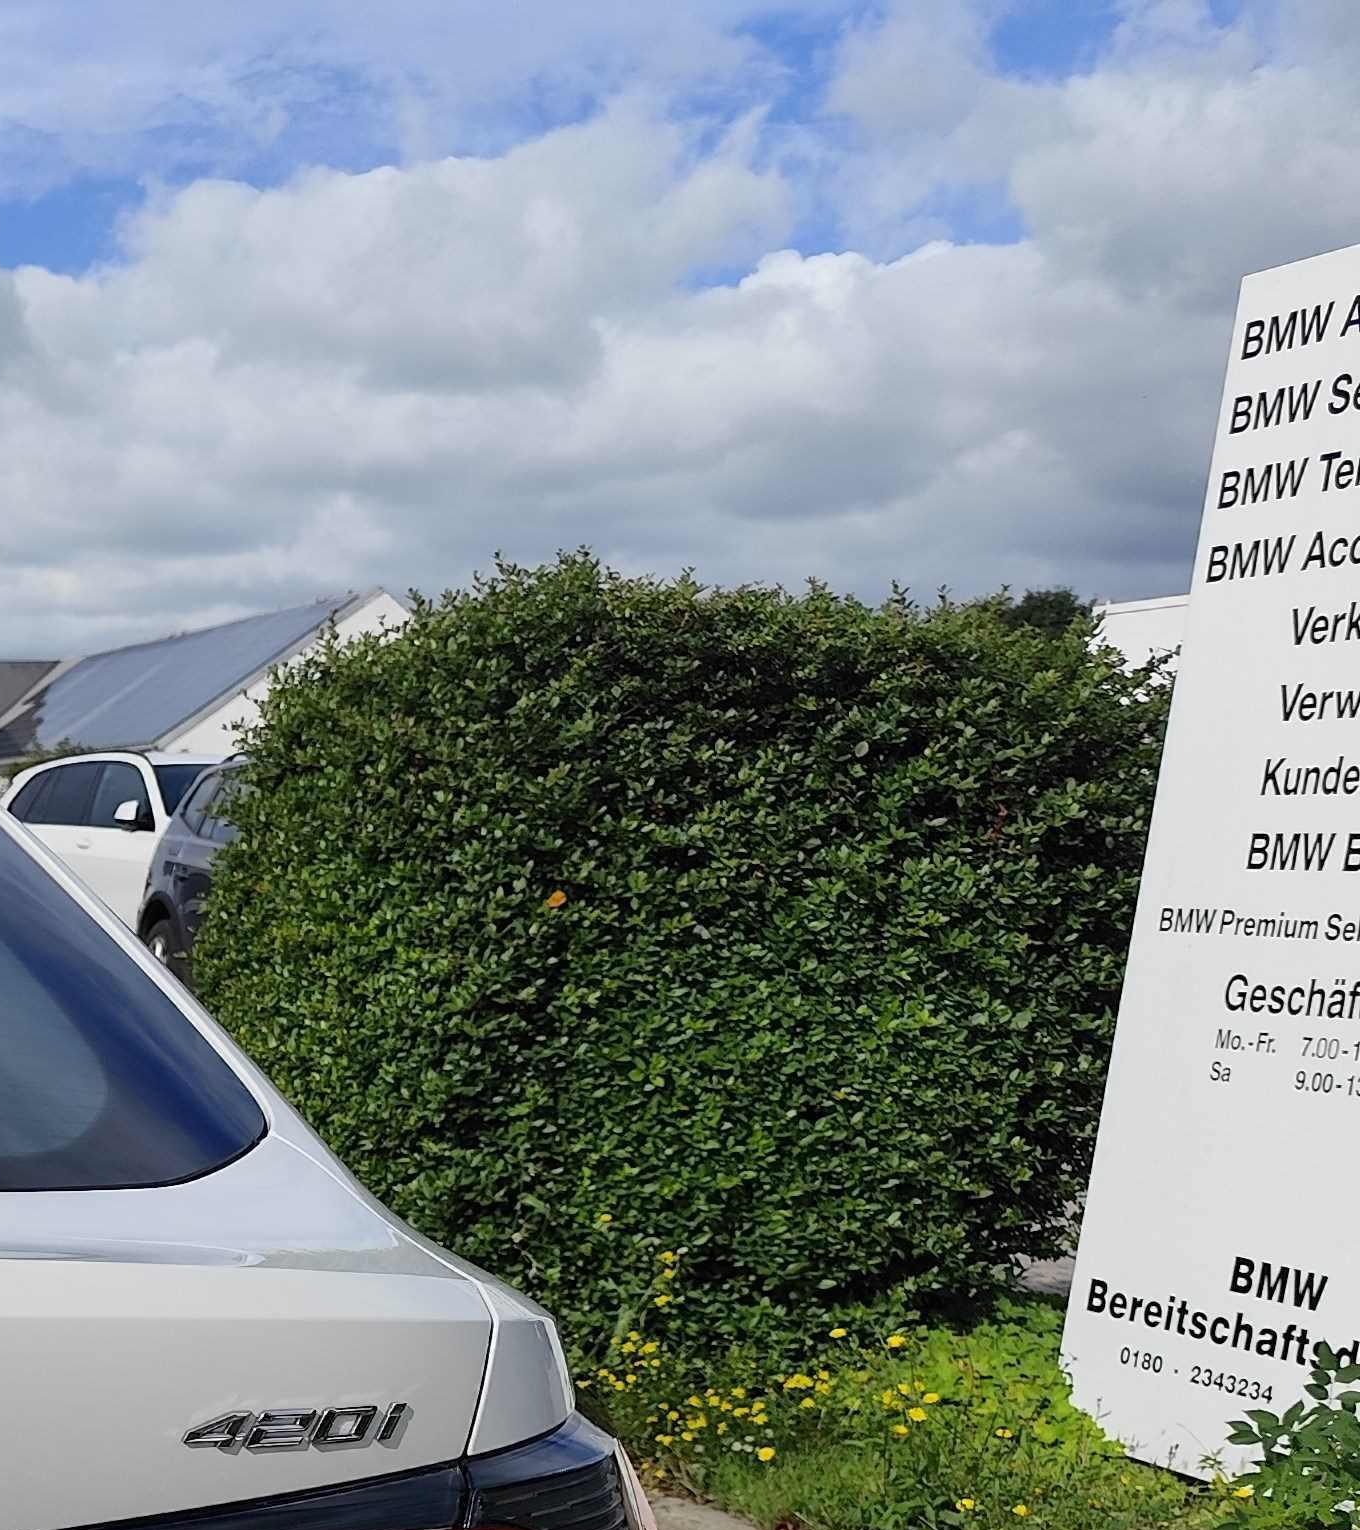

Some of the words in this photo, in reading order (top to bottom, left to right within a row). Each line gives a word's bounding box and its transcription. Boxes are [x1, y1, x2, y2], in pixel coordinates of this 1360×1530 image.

[1241, 301, 1335, 360] BMW
[1229, 380, 1322, 434] BMW
[1217, 457, 1309, 509] BMW
[1206, 535, 1296, 583] BMW
[1292, 602, 1360, 645] Verk
[1281, 683, 1360, 721] Verw
[1260, 756, 1360, 796] Kunde
[1246, 833, 1336, 871] BMW
[1159, 908, 1217, 933] BMW
[1219, 909, 1319, 940] Premium
[1210, 1061, 1231, 1082] Sa
[1229, 1256, 1329, 1311] BMW
[1120, 1347, 1164, 1374] 0180
[1190, 1366, 1273, 1404] 2343234
[182, 1401, 412, 1455] 420i
